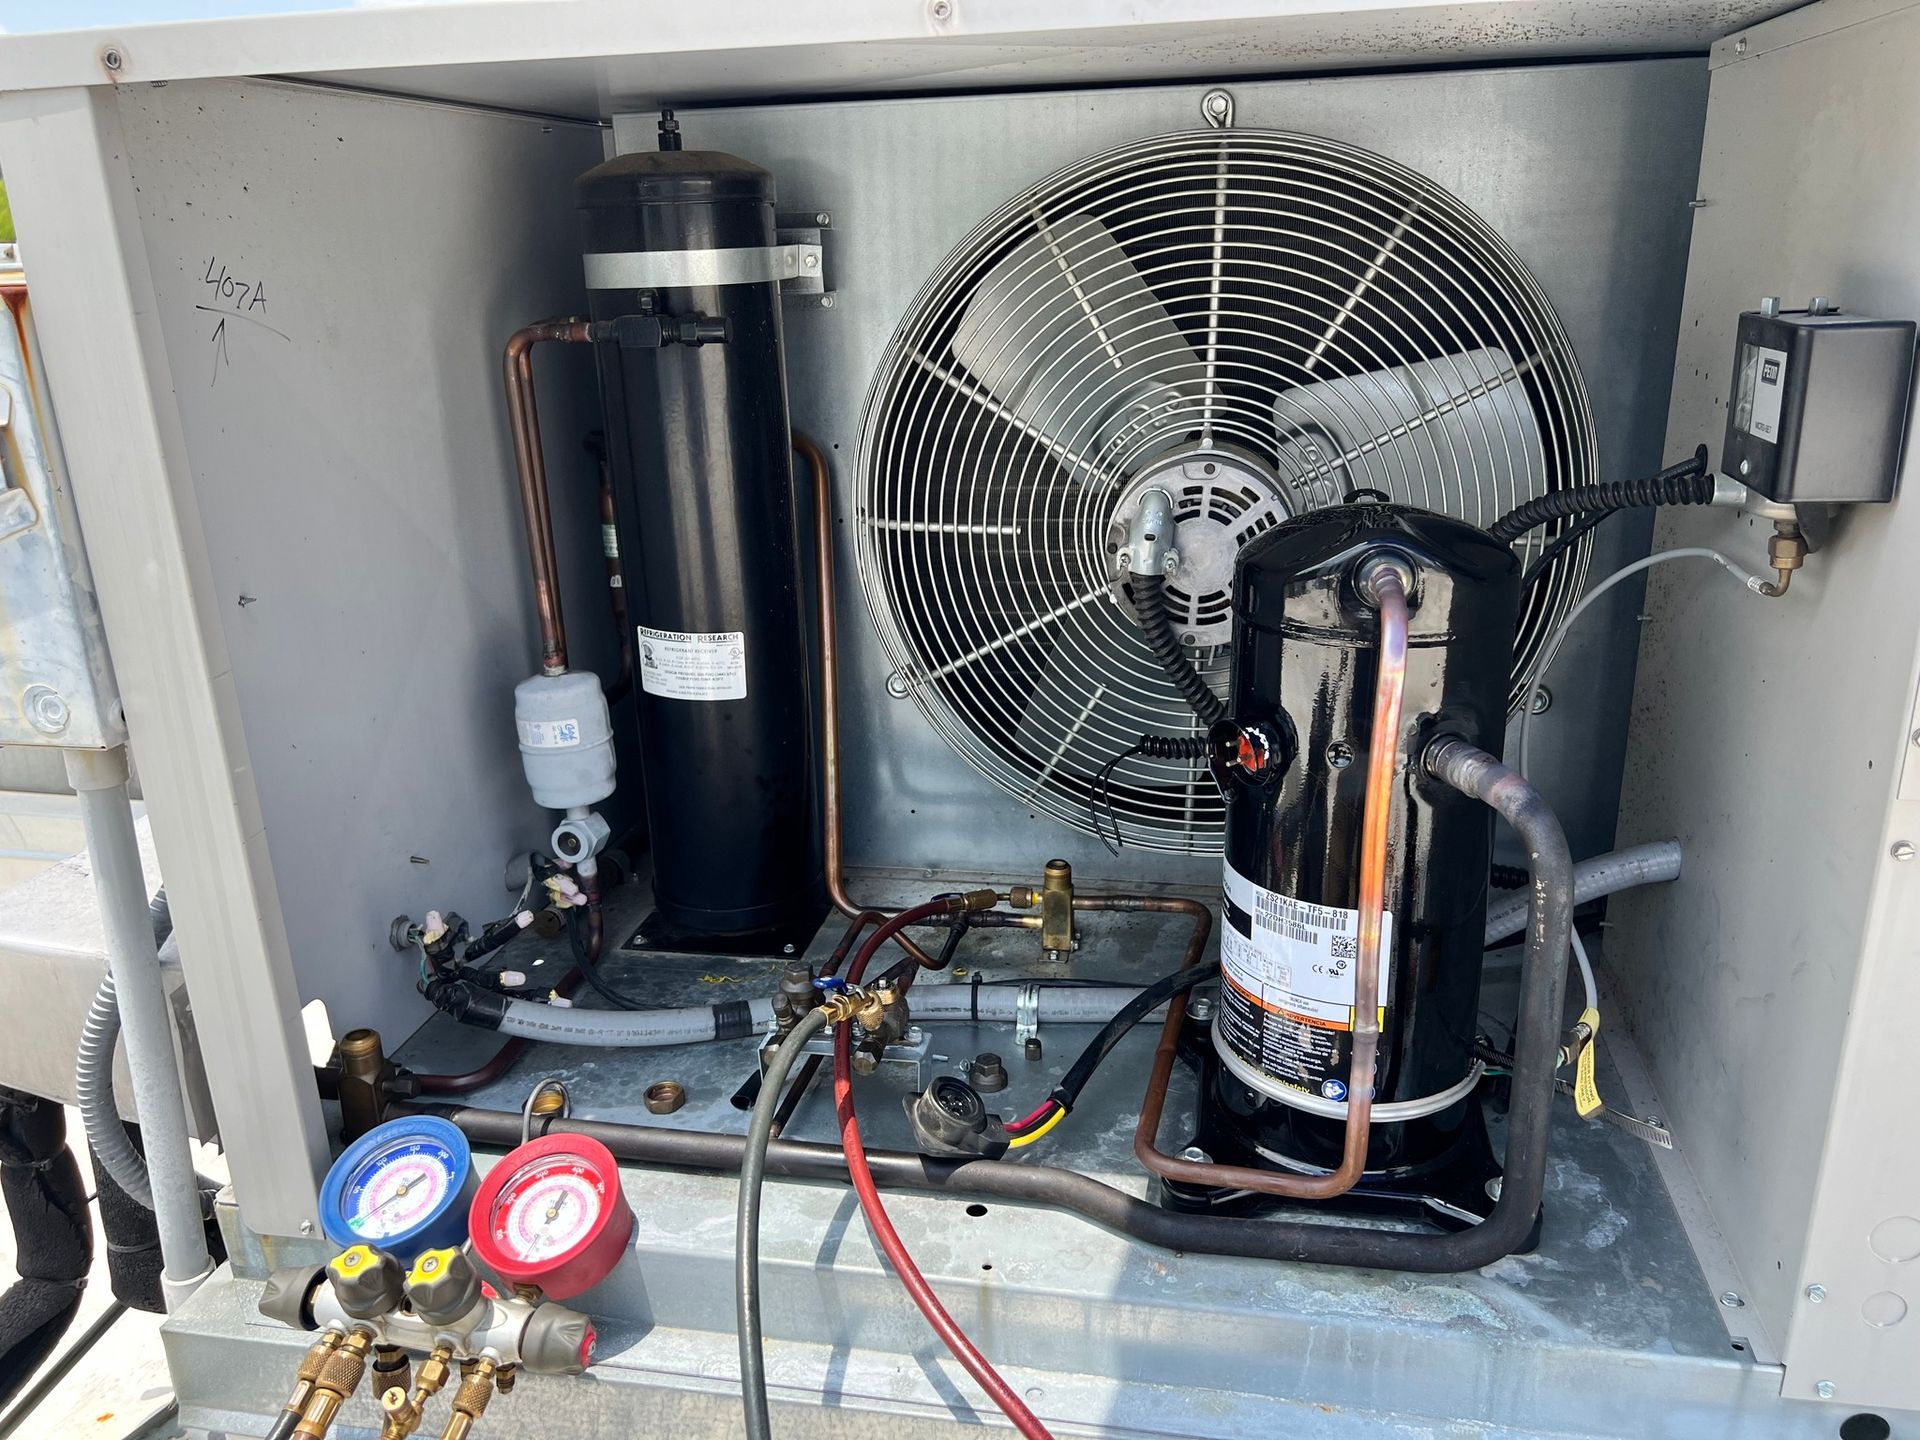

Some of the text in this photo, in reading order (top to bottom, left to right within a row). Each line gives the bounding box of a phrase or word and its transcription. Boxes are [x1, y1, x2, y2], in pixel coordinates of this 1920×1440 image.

[205, 256, 267, 314] 407A
[640, 627, 739, 643] REFRIGERATION RESEARCH
[1286, 1013, 1327, 1026] ADVERTENCIA
